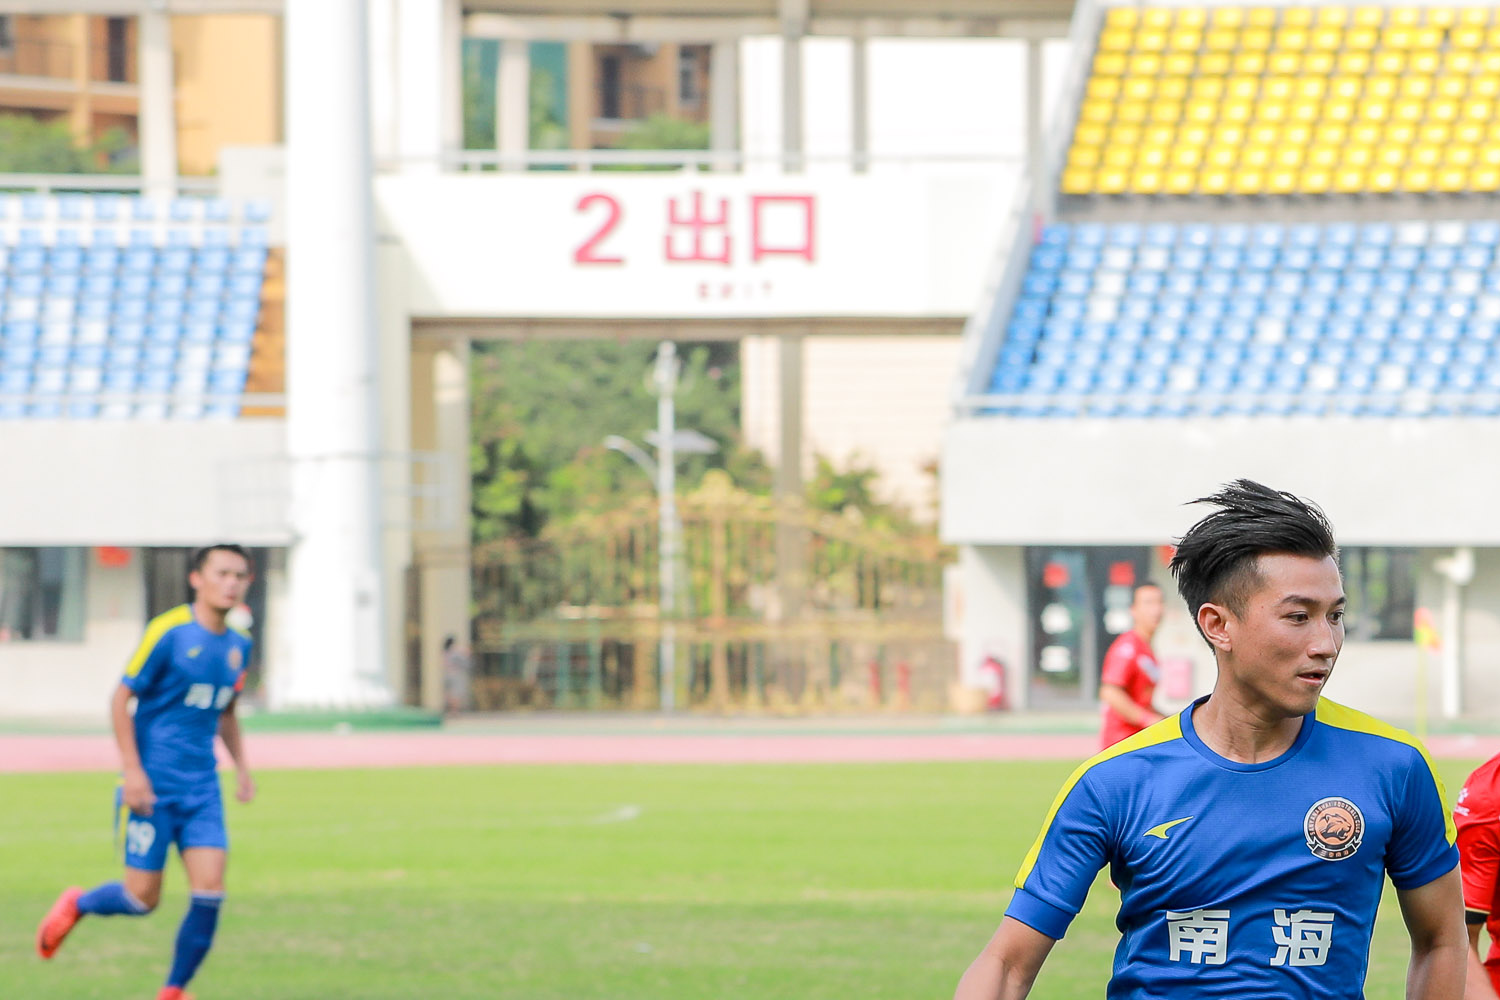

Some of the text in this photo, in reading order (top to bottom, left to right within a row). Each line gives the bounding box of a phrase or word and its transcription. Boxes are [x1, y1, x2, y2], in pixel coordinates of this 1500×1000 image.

[573, 190, 816, 265] 2 出口
[1165, 908, 1335, 966] 南海
